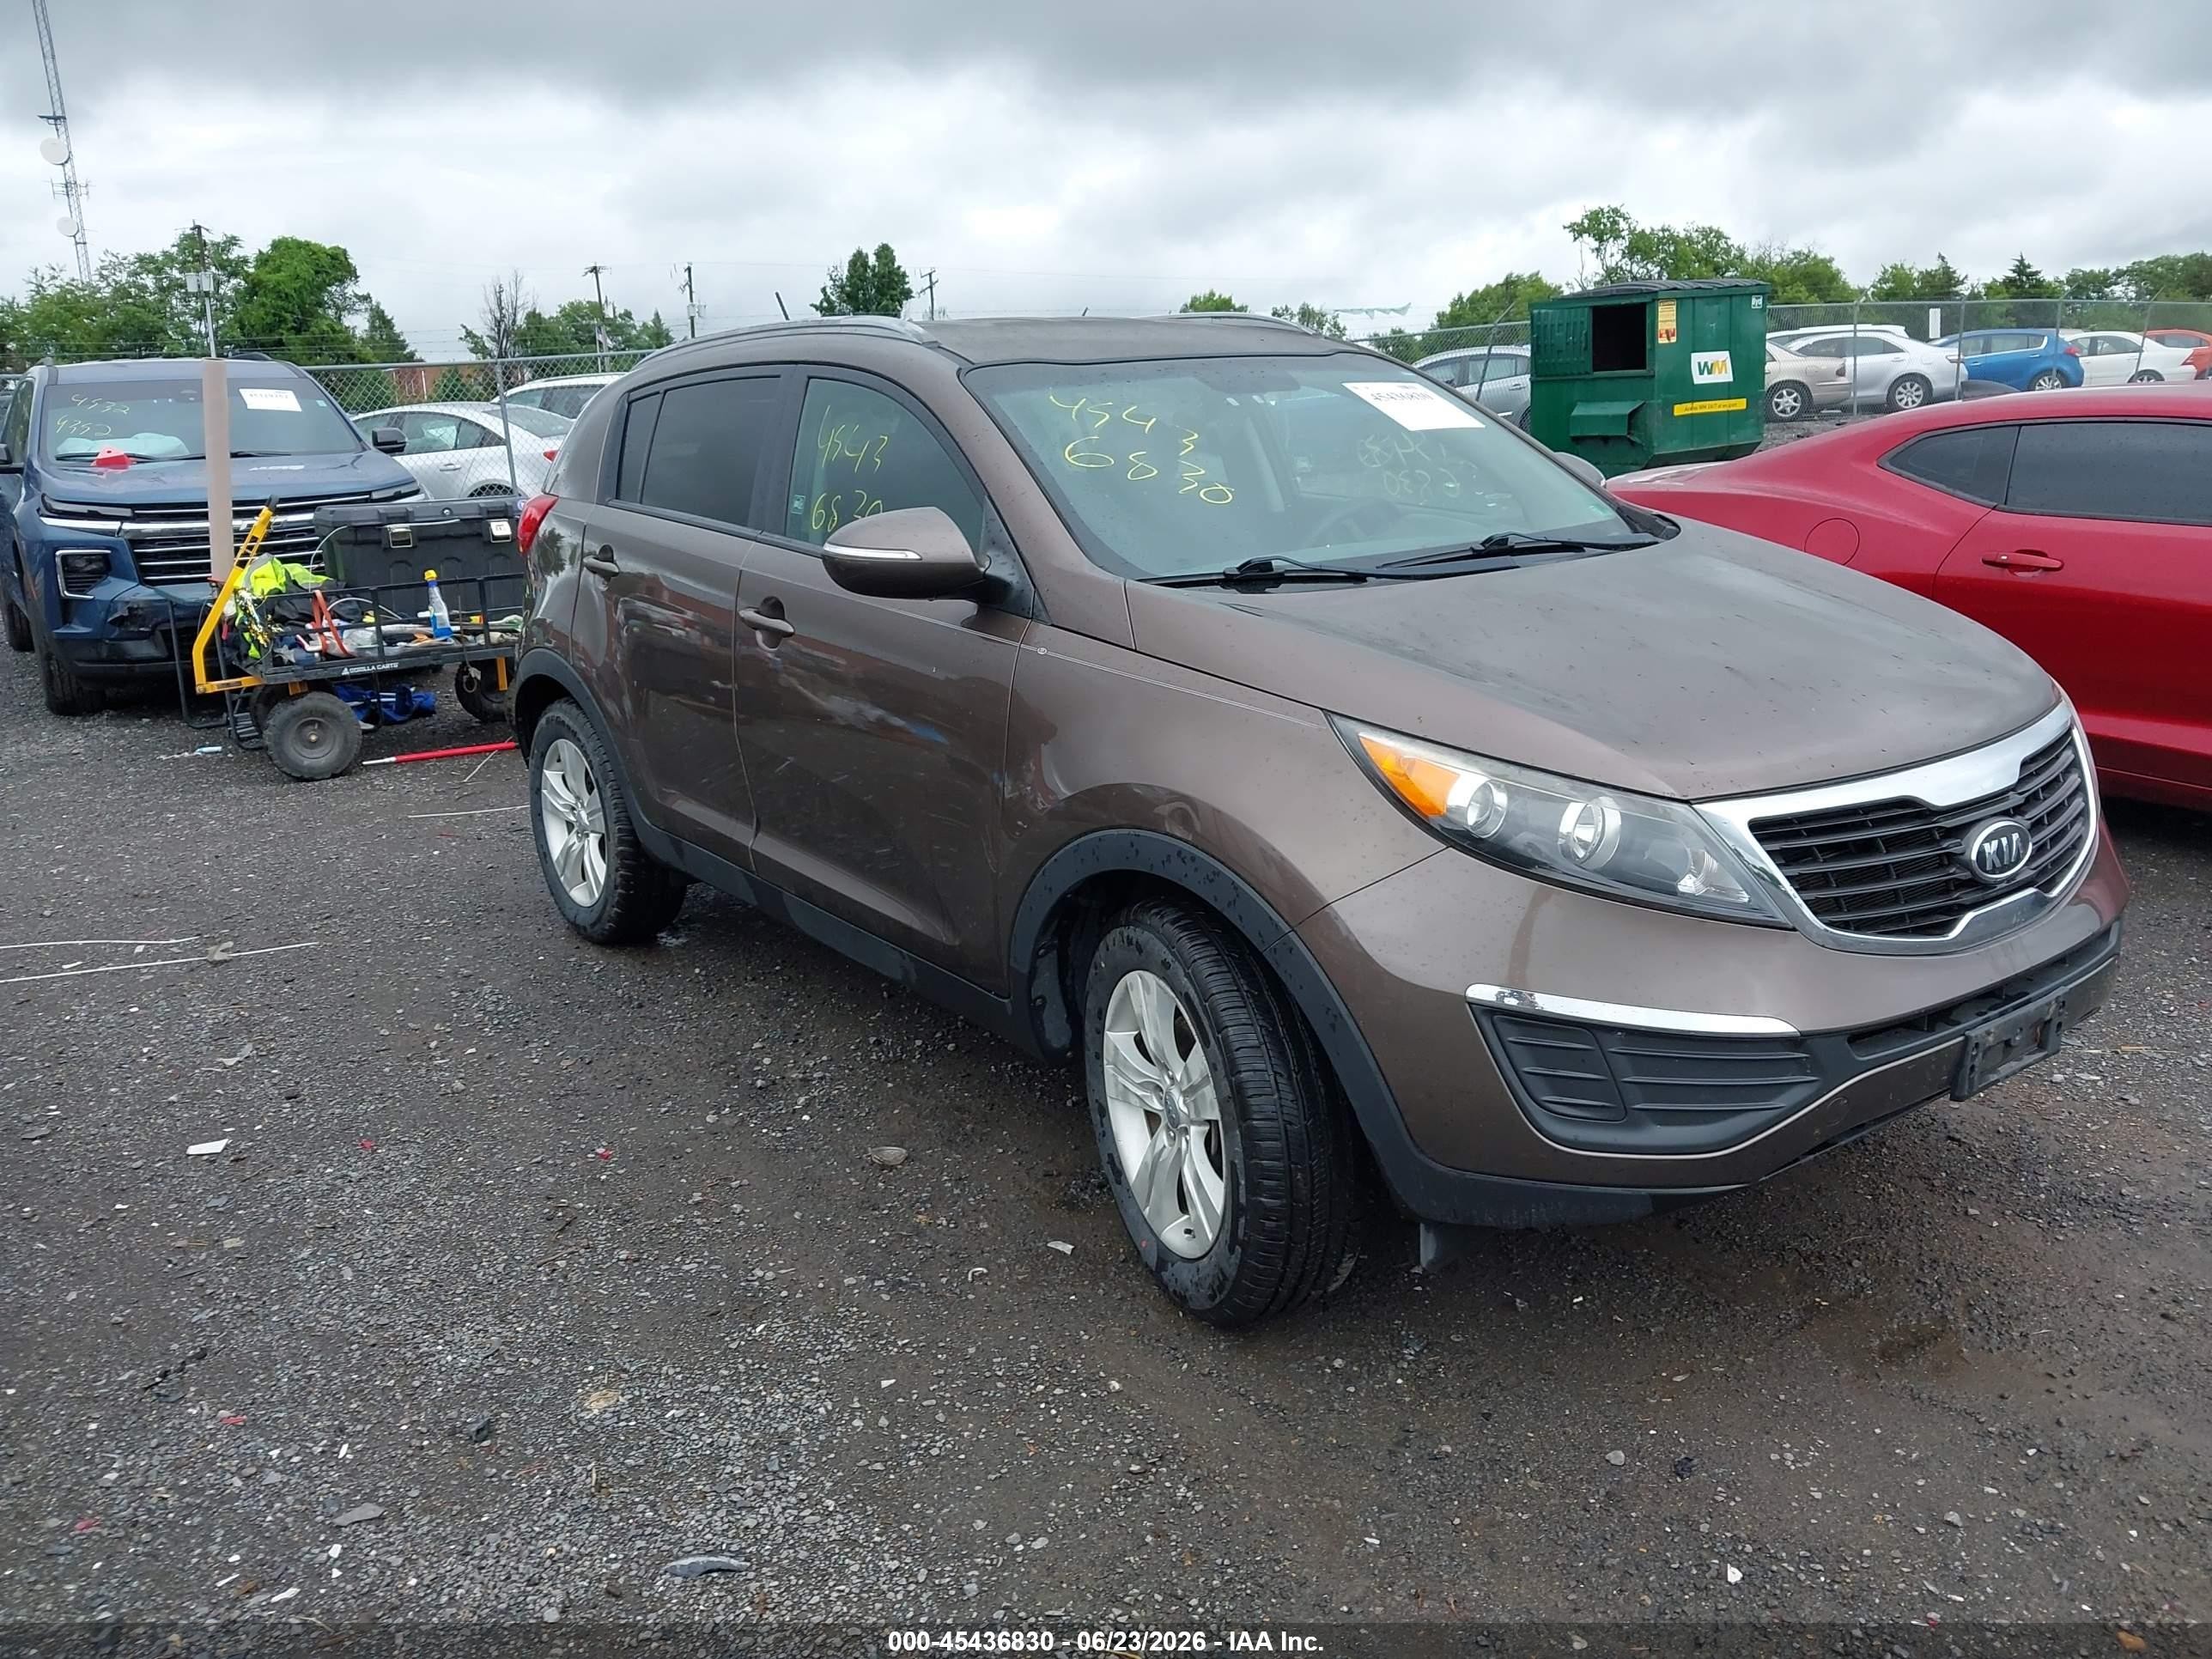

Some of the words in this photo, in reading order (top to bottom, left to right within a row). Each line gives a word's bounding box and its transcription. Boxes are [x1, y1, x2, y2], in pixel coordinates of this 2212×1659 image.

[1697, 358, 1729, 375] WM
[817, 405, 888, 474] 4543
[1982, 832, 2023, 871] KIA
